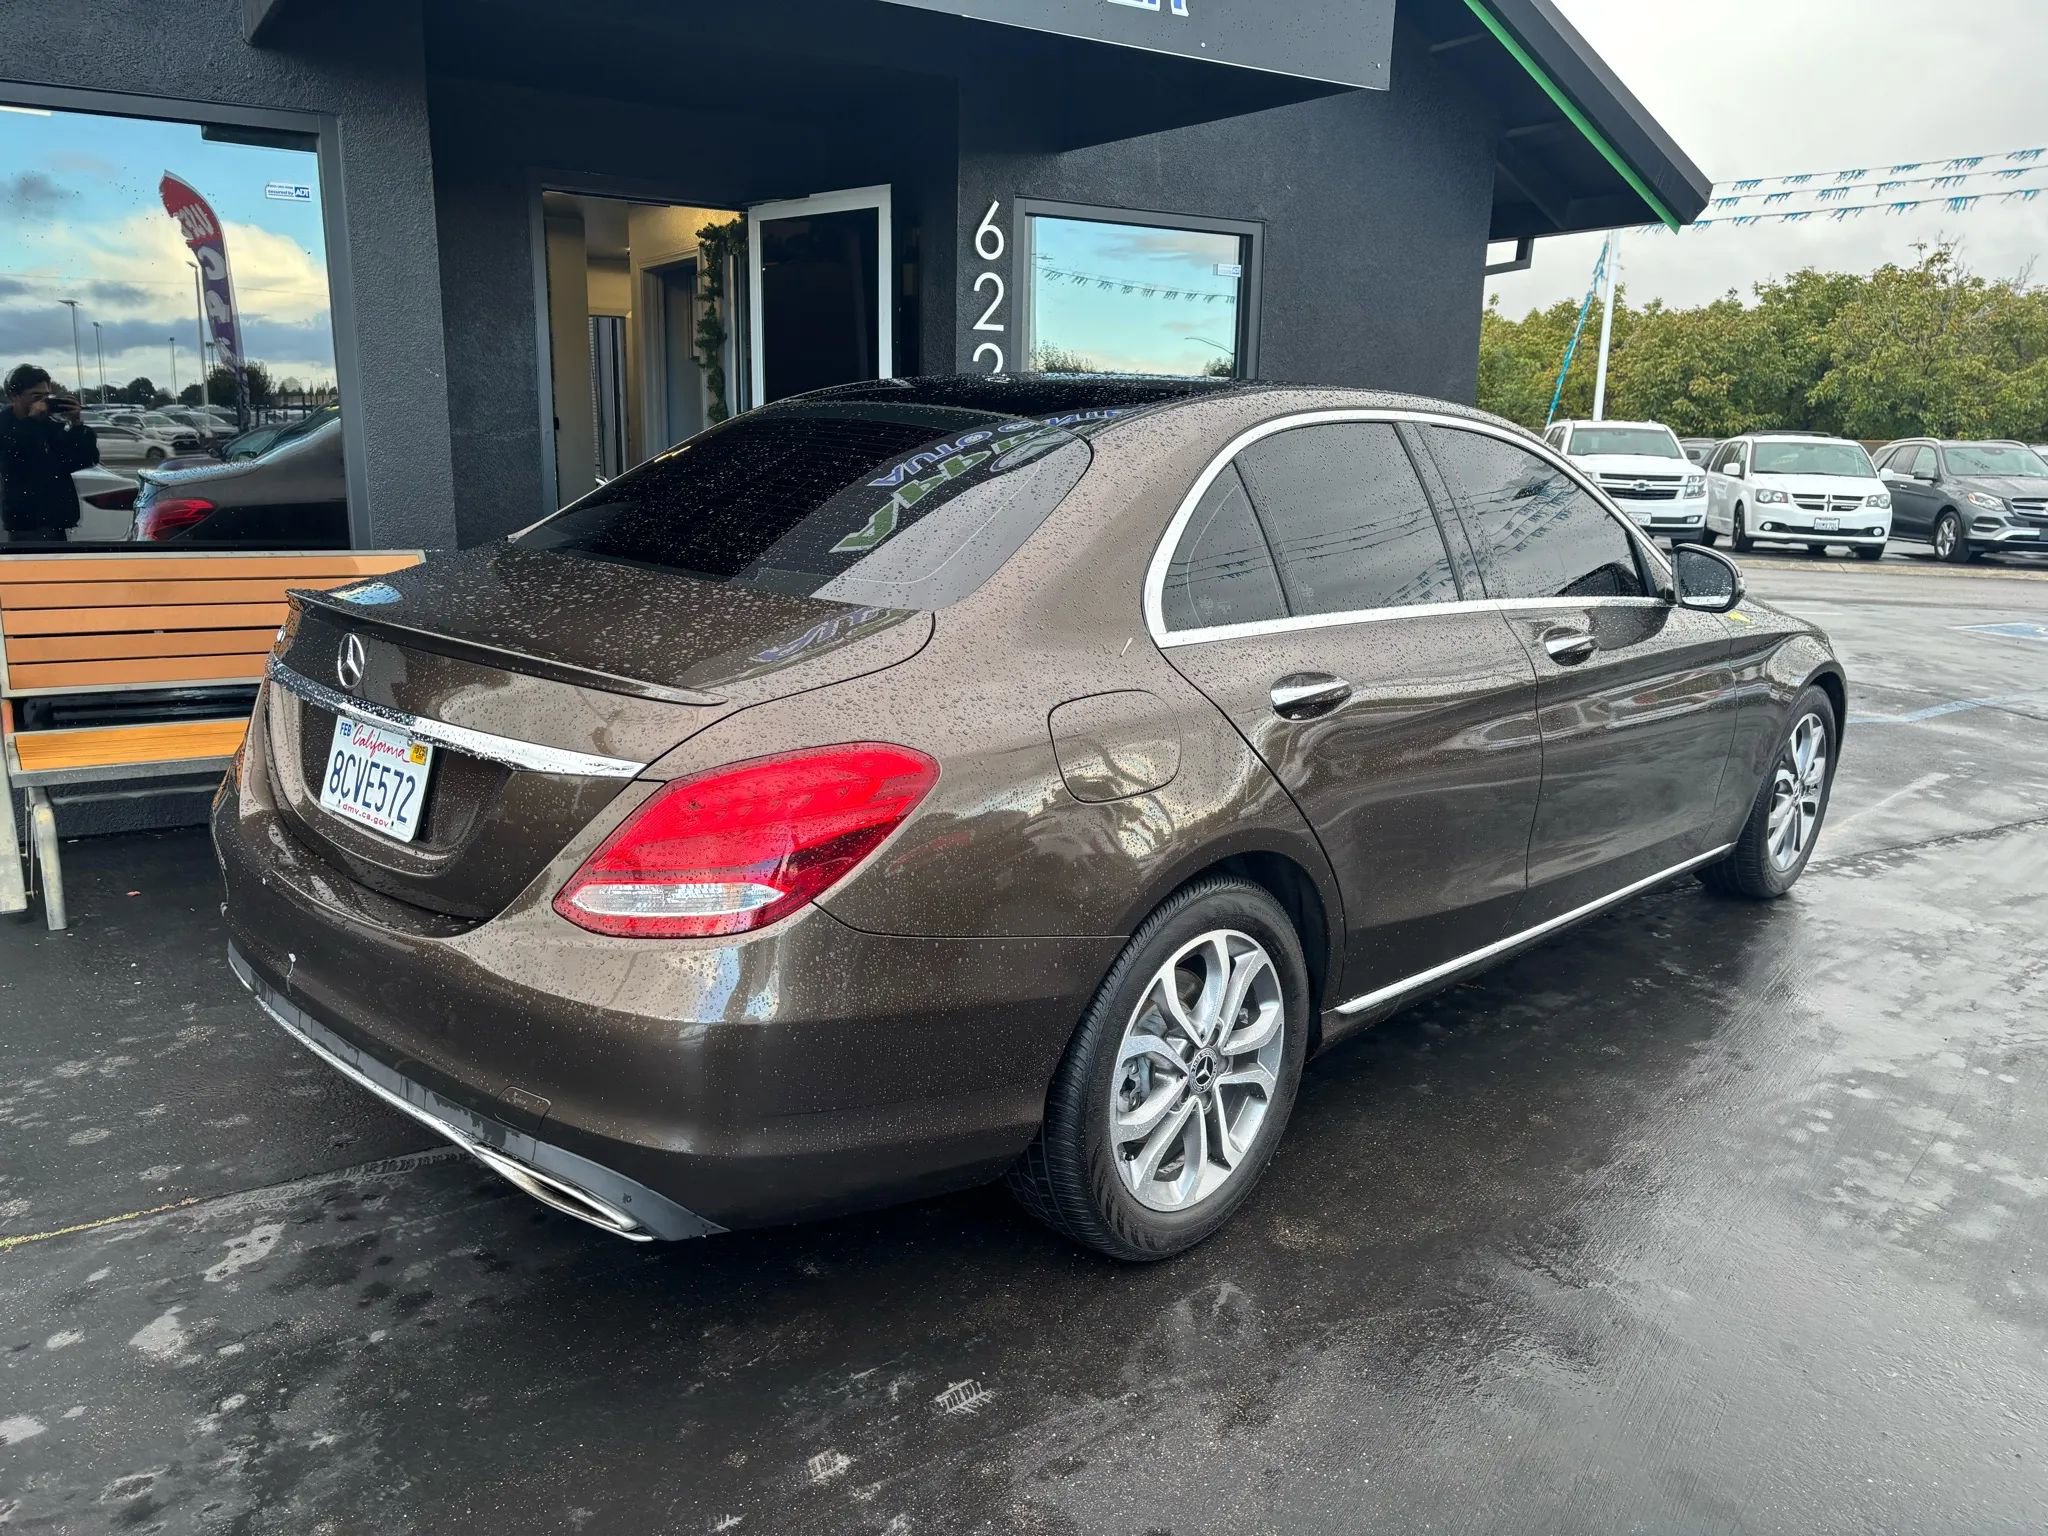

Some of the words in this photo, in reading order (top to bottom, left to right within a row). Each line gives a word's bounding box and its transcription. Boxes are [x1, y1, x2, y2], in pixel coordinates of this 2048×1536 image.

[340, 722, 352, 736] FEB
[352, 724, 410, 763] California
[329, 749, 416, 824] 8CVE572
[342, 803, 389, 828] dmv.ca.gov
